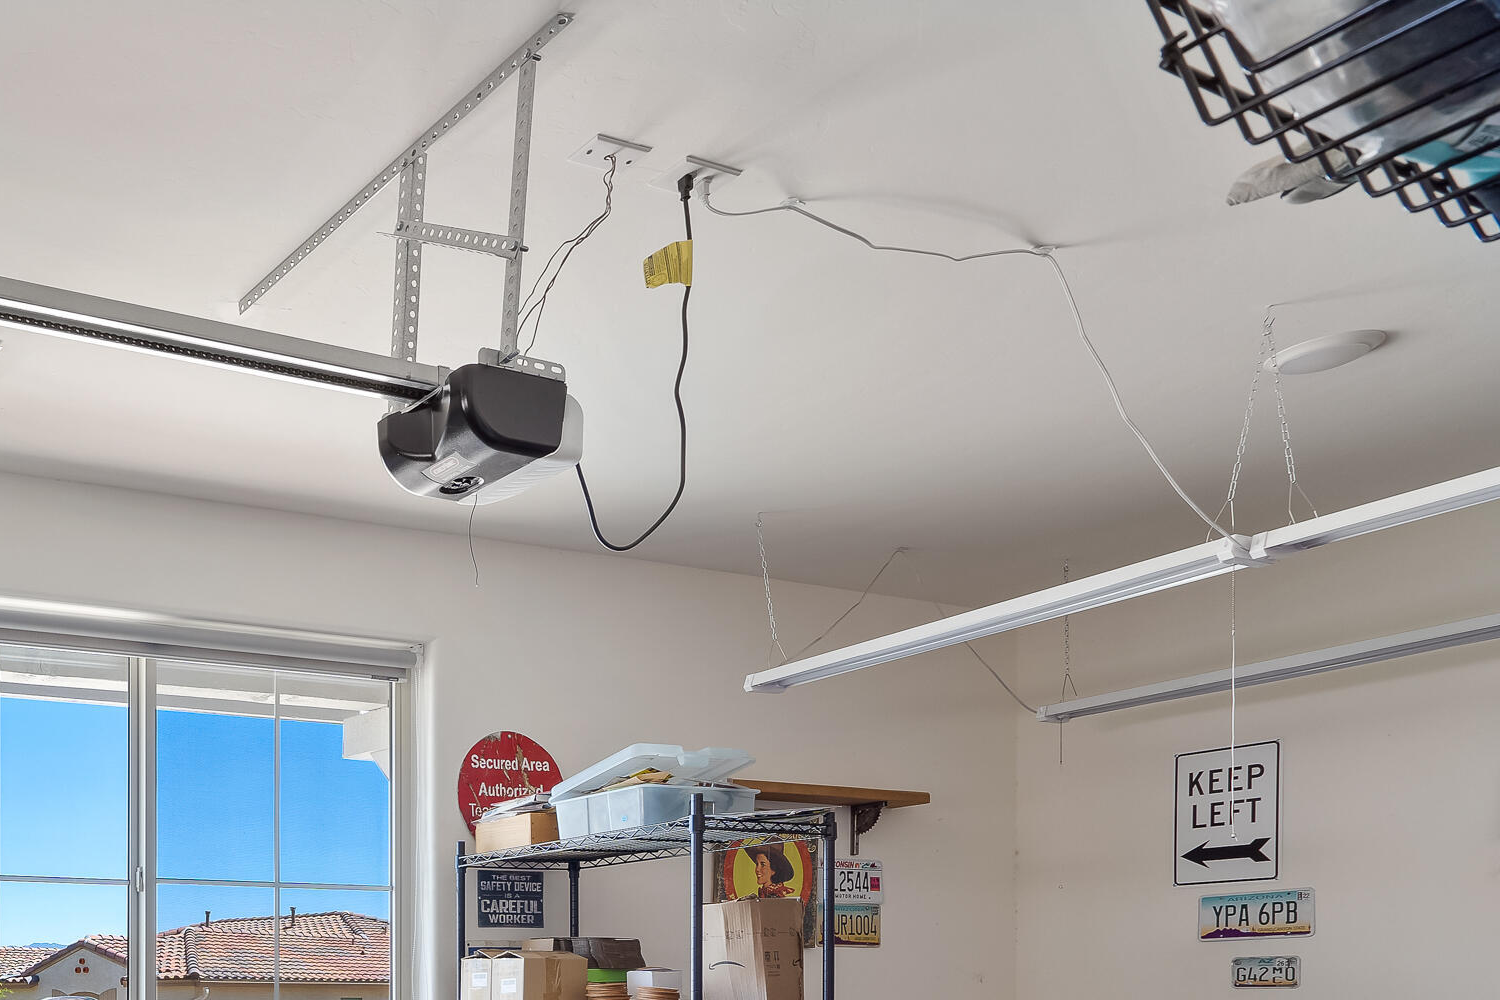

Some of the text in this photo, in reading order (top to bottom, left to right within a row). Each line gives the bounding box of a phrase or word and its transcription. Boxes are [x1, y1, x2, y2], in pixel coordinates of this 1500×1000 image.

[470, 754, 550, 772] Secured Area
[1188, 764, 1265, 796] KEEP
[478, 782, 544, 798] Authorized
[1192, 797, 1262, 829] LEFT
[480, 881, 542, 892] SAFETY DEVICE
[1227, 894, 1284, 902] ARIZONA
[480, 900, 542, 914] CAREFUL
[1212, 901, 1298, 928] YPA 6PB
[488, 914, 535, 924] WORKER
